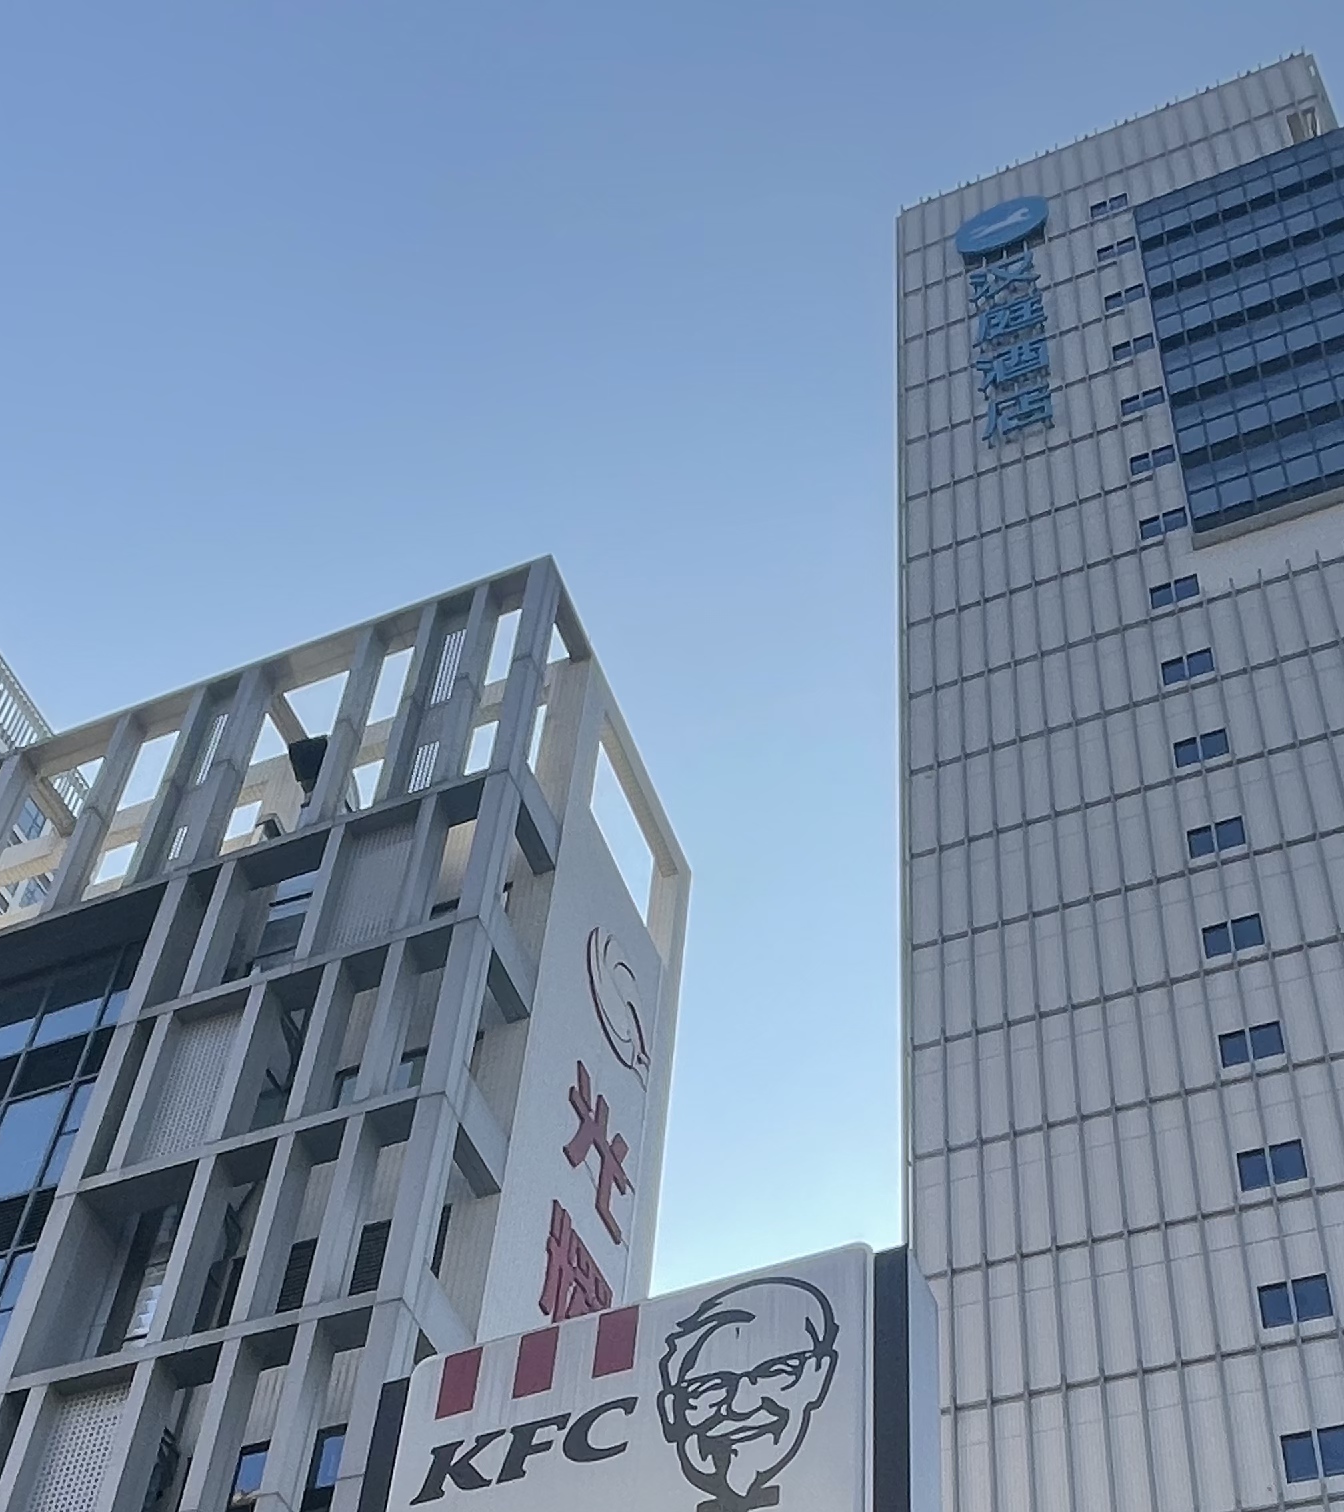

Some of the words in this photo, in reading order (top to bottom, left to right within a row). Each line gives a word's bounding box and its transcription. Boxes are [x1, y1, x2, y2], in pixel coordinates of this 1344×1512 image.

[969, 250, 1054, 441] 汉庭酒店
[409, 1397, 639, 1505] KFC
